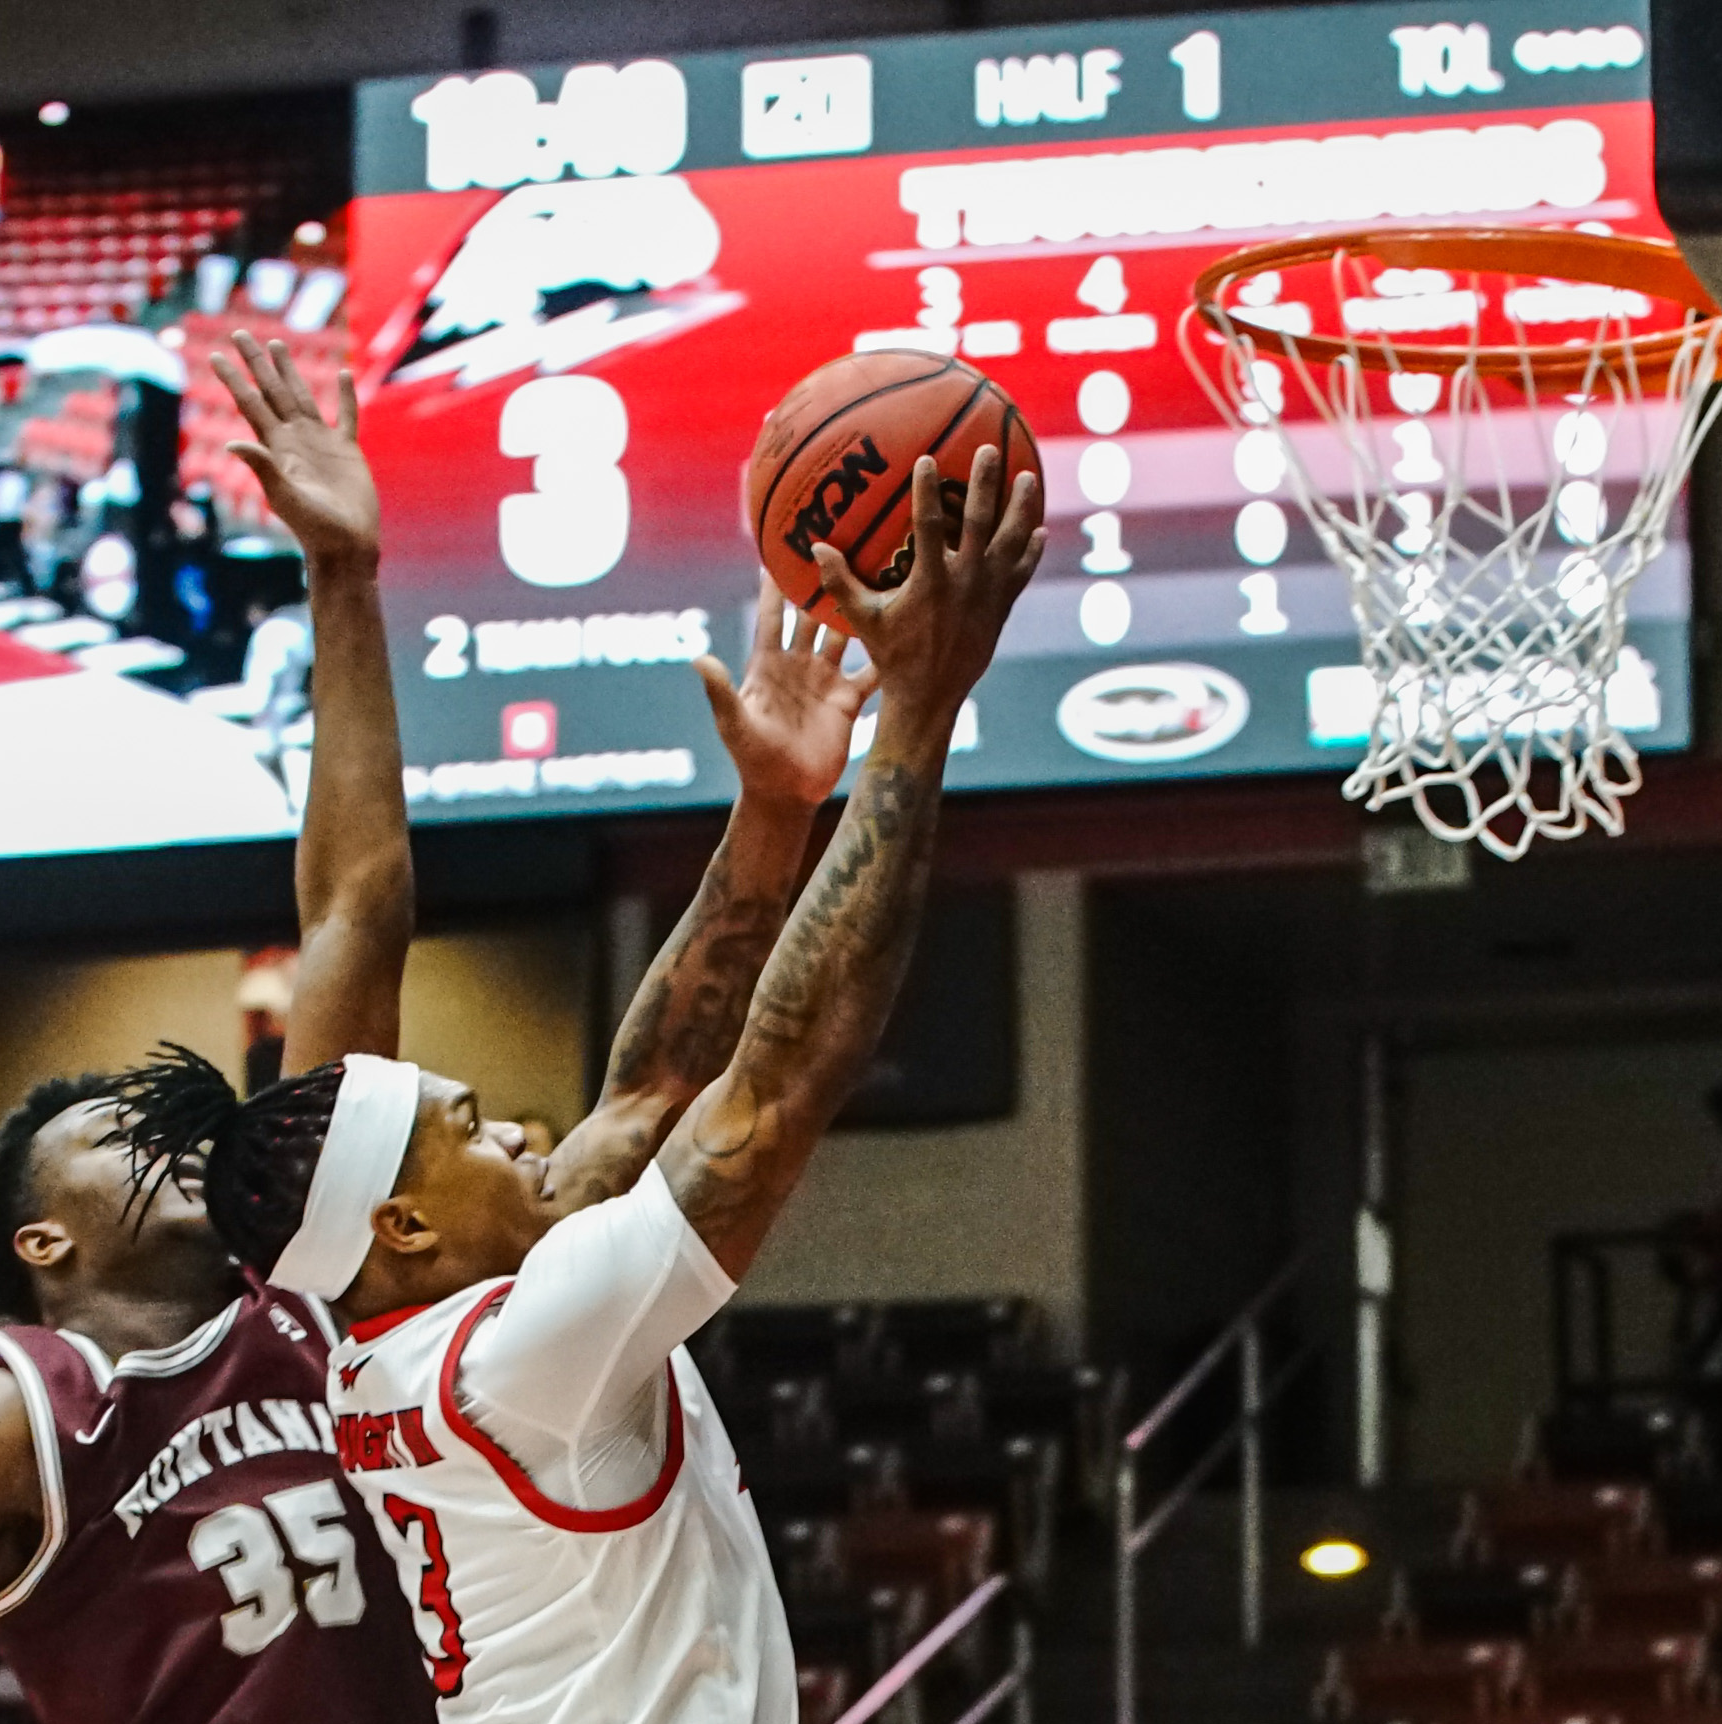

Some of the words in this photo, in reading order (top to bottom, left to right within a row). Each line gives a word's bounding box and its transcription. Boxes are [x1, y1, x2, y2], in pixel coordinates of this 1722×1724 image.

[975, 48, 1121, 126] HALF
[1170, 31, 1221, 121] 1
[1391, 23, 1505, 97] TOL
[499, 375, 629, 588] 3
[188, 1478, 366, 1657] 35
